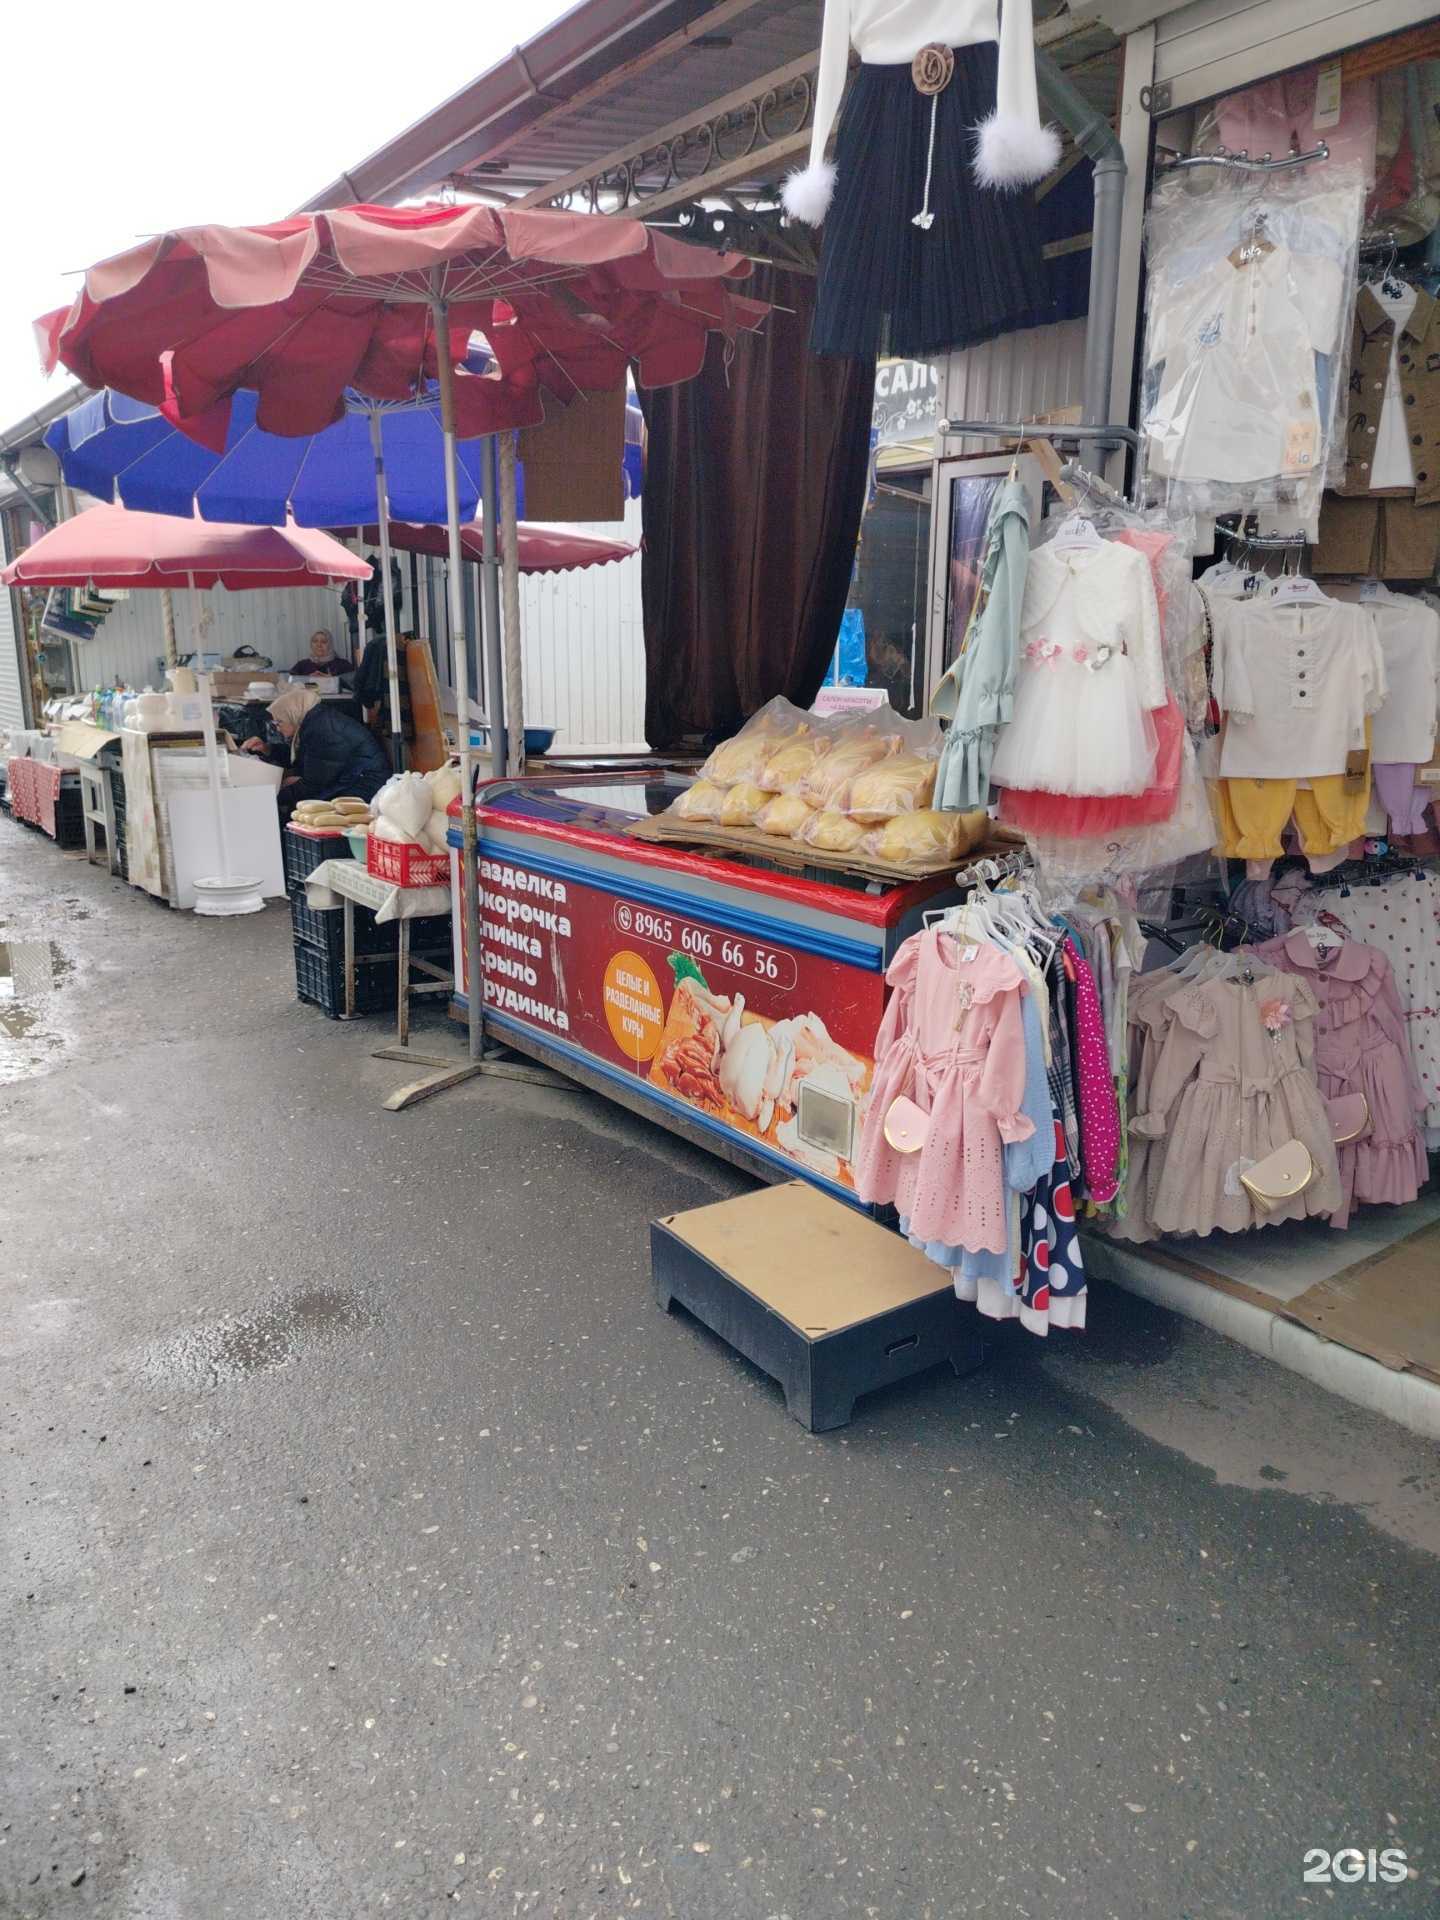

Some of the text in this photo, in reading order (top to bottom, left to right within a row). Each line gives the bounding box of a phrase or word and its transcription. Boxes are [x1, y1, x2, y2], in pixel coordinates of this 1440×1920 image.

[477, 856, 567, 904] азделка
[479, 914, 542, 959] пинка
[635, 912, 778, 979] 8965 606 66 56
[481, 973, 569, 1031] рудинка
[616, 969, 650, 996] ЦЕЛЫЕ И
[605, 986, 661, 1025] РАЗДЕЛАННЫЕ
[622, 1015, 644, 1040] КУРЫ
